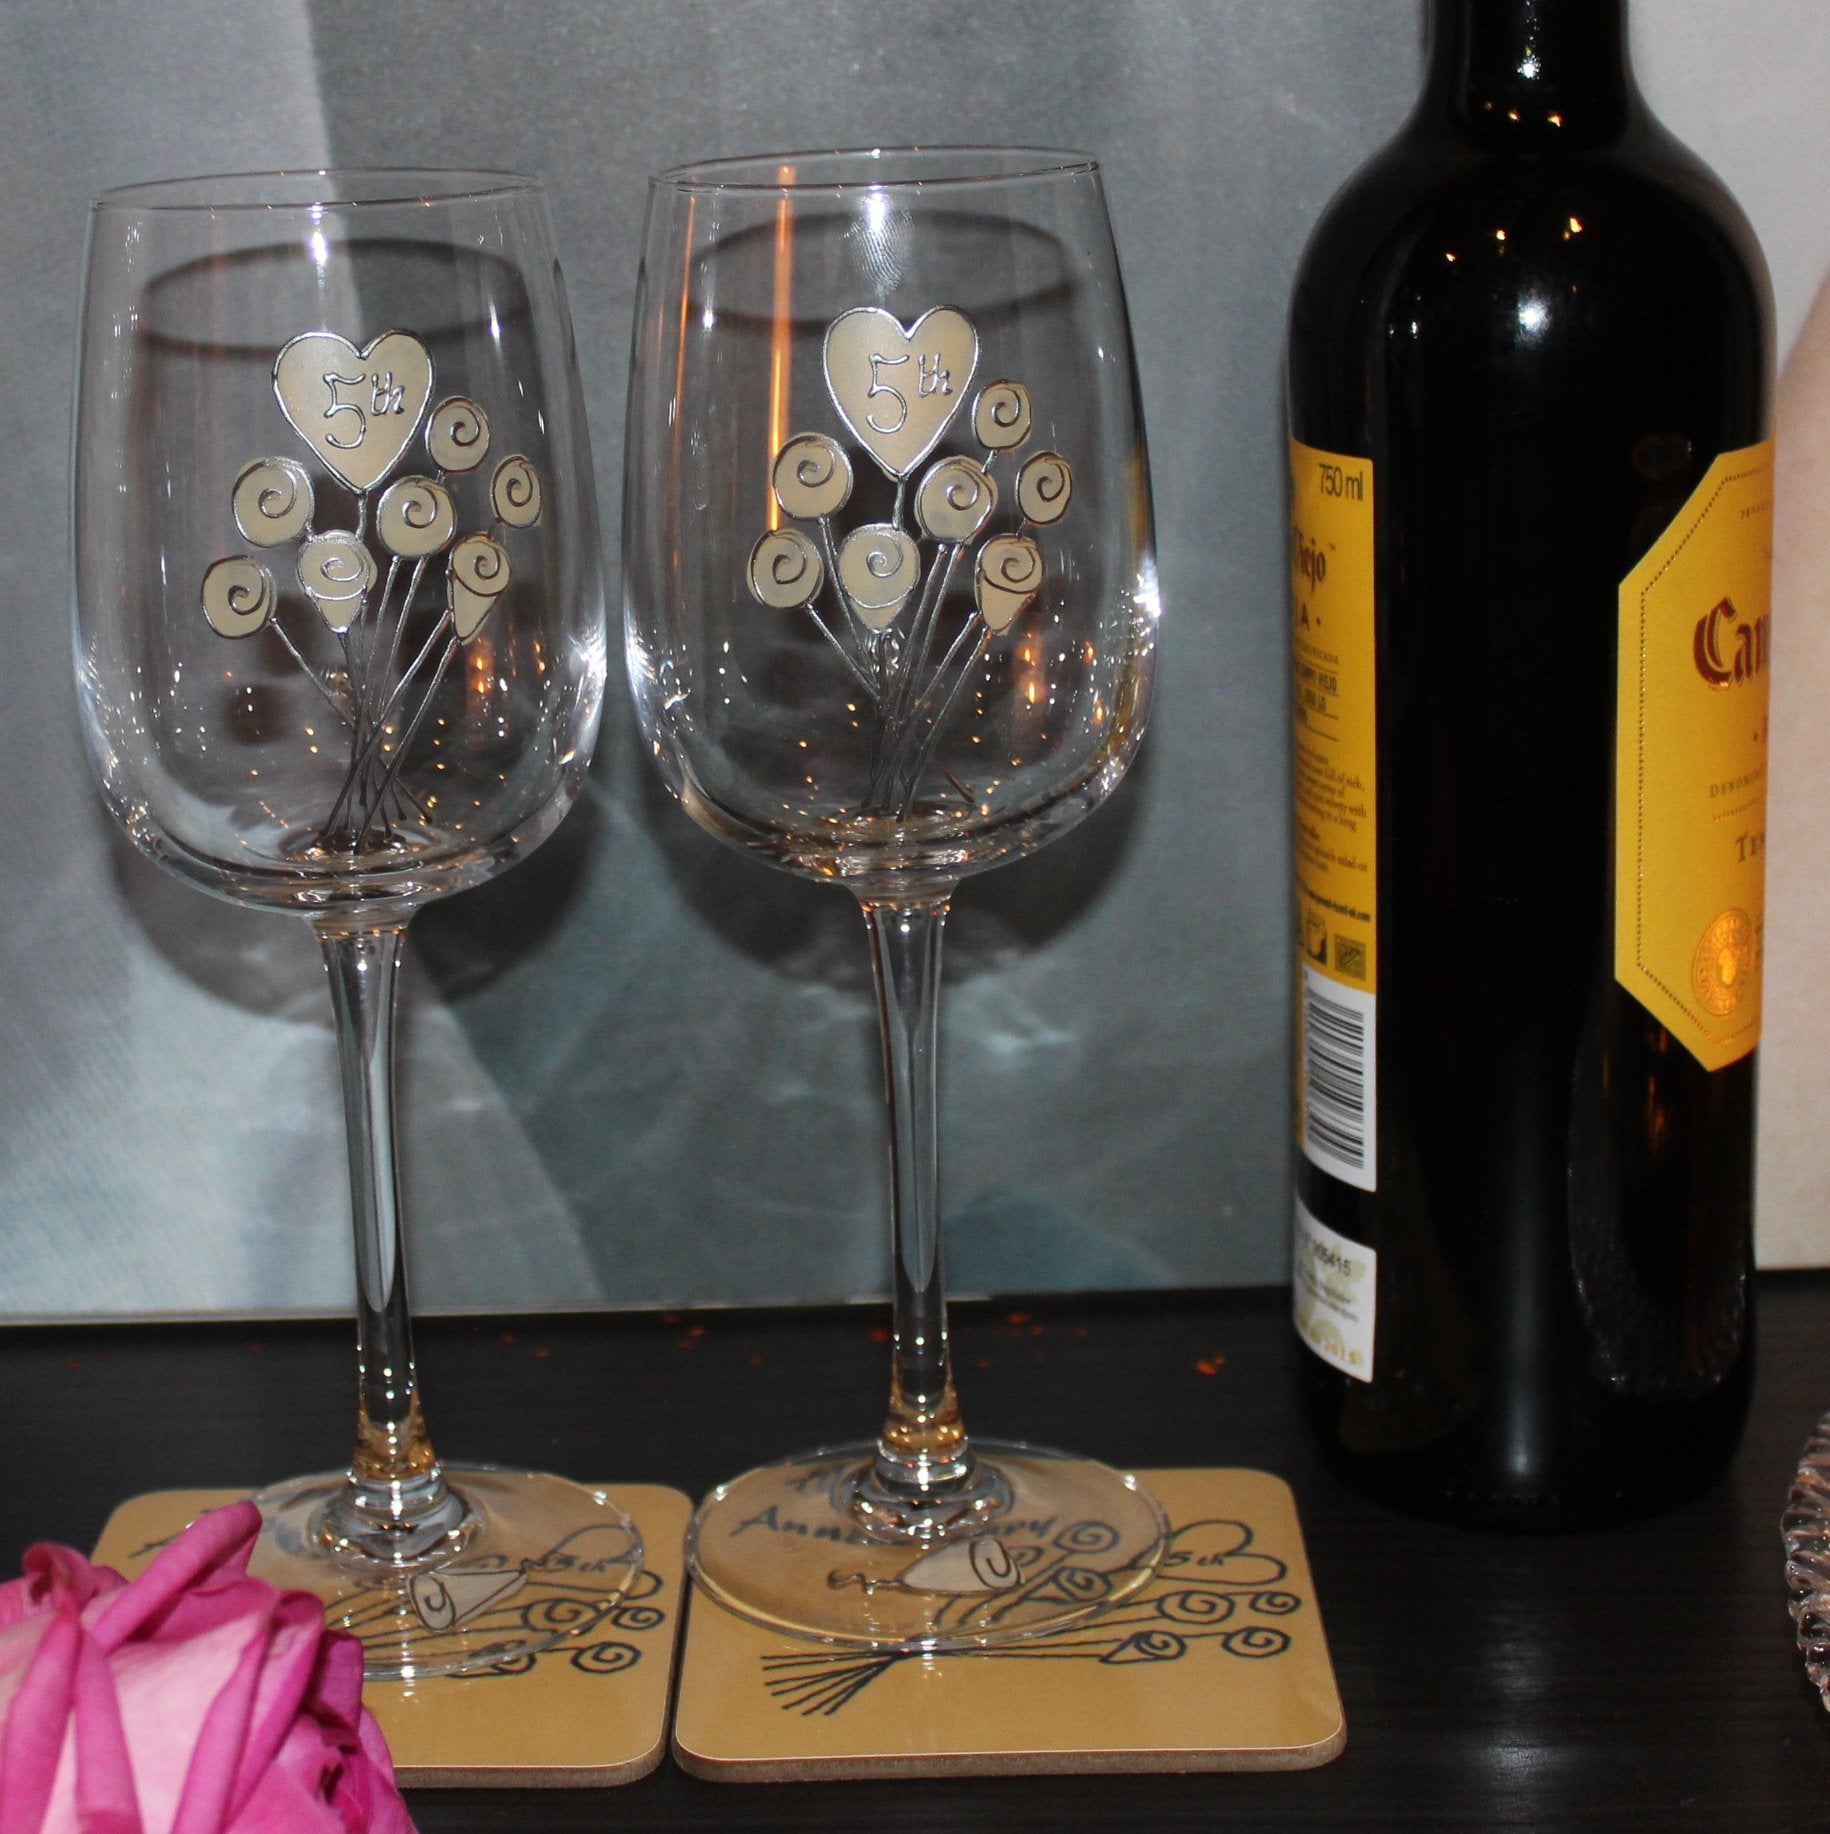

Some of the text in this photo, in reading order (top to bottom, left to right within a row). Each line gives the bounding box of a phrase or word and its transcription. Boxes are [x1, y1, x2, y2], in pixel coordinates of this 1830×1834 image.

[322, 372, 405, 449] 5th
[866, 353, 953, 434] 5th
[1318, 463, 1364, 501] 750 ml
